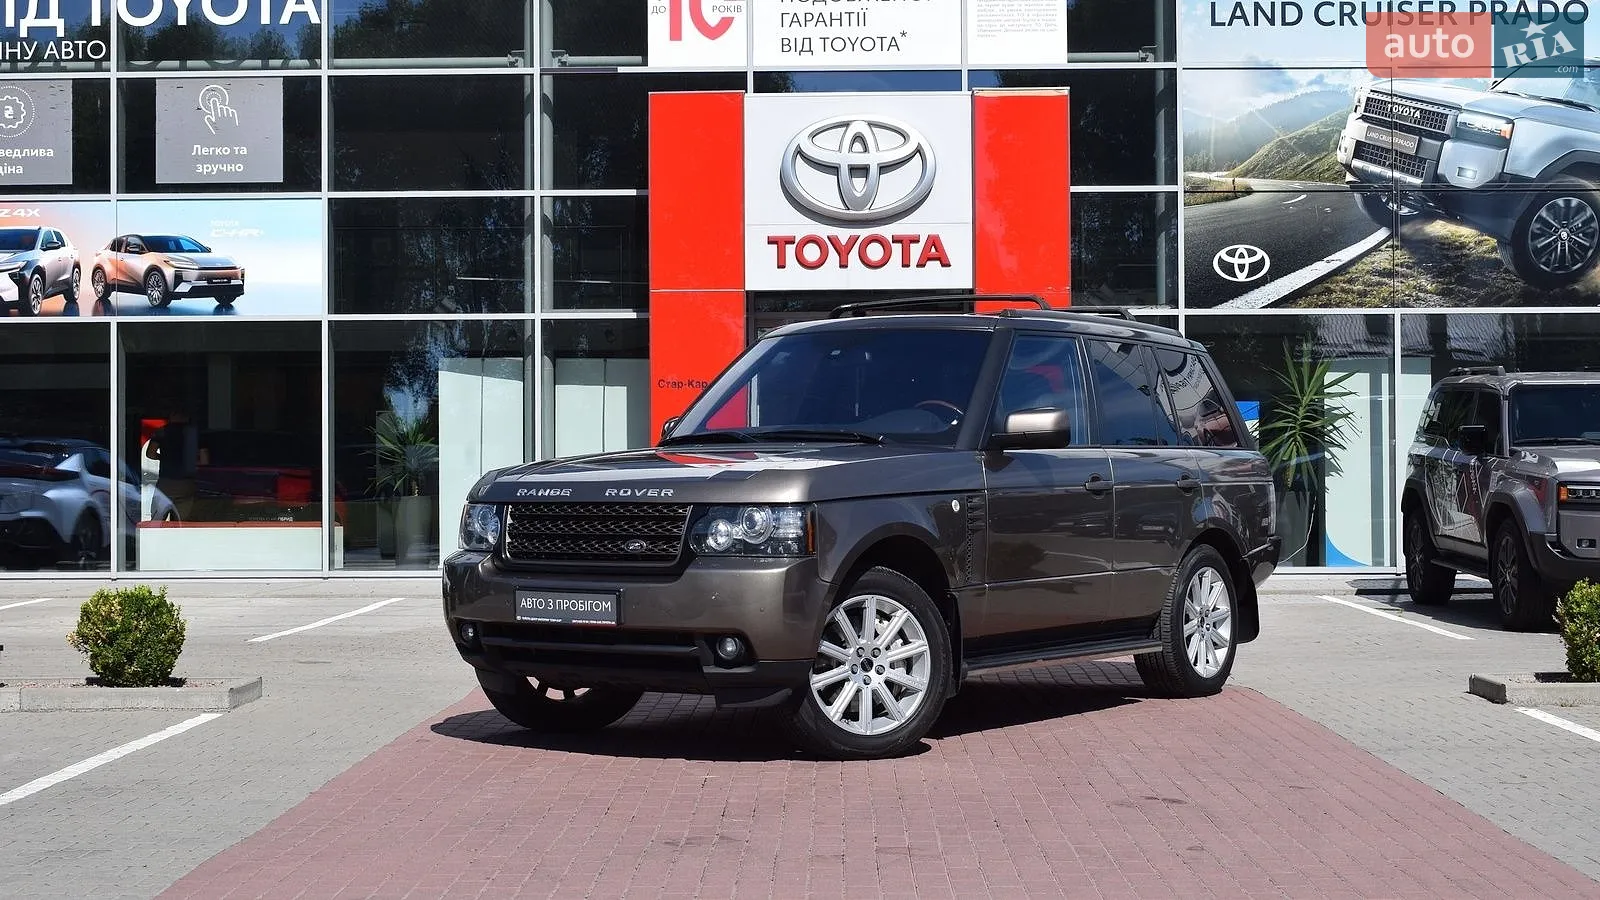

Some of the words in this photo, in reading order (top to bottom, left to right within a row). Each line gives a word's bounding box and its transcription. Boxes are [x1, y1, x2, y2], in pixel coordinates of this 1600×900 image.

[651, 5, 667, 15] ДО
[712, 5, 742, 13] РОКІВ
[1210, 1, 1303, 27] LAND
[1313, 1, 1458, 26] CRUISER
[1469, 0, 1589, 26] PRADO
[780, 8, 868, 27] ГАРАНТІЇ
[44, 40, 106, 60] АВТО
[780, 37, 813, 56] ВІД
[1387, 104, 1421, 119] TOYOTA
[191, 144, 231, 156] Легко
[233, 146, 248, 155] та
[195, 163, 244, 175] зручно
[767, 234, 952, 270] TOYOTA
[516, 488, 573, 497] RANGE
[604, 488, 674, 497] ROVER
[520, 598, 545, 610] АВТО
[556, 599, 611, 612] ПРОБІГОМ
